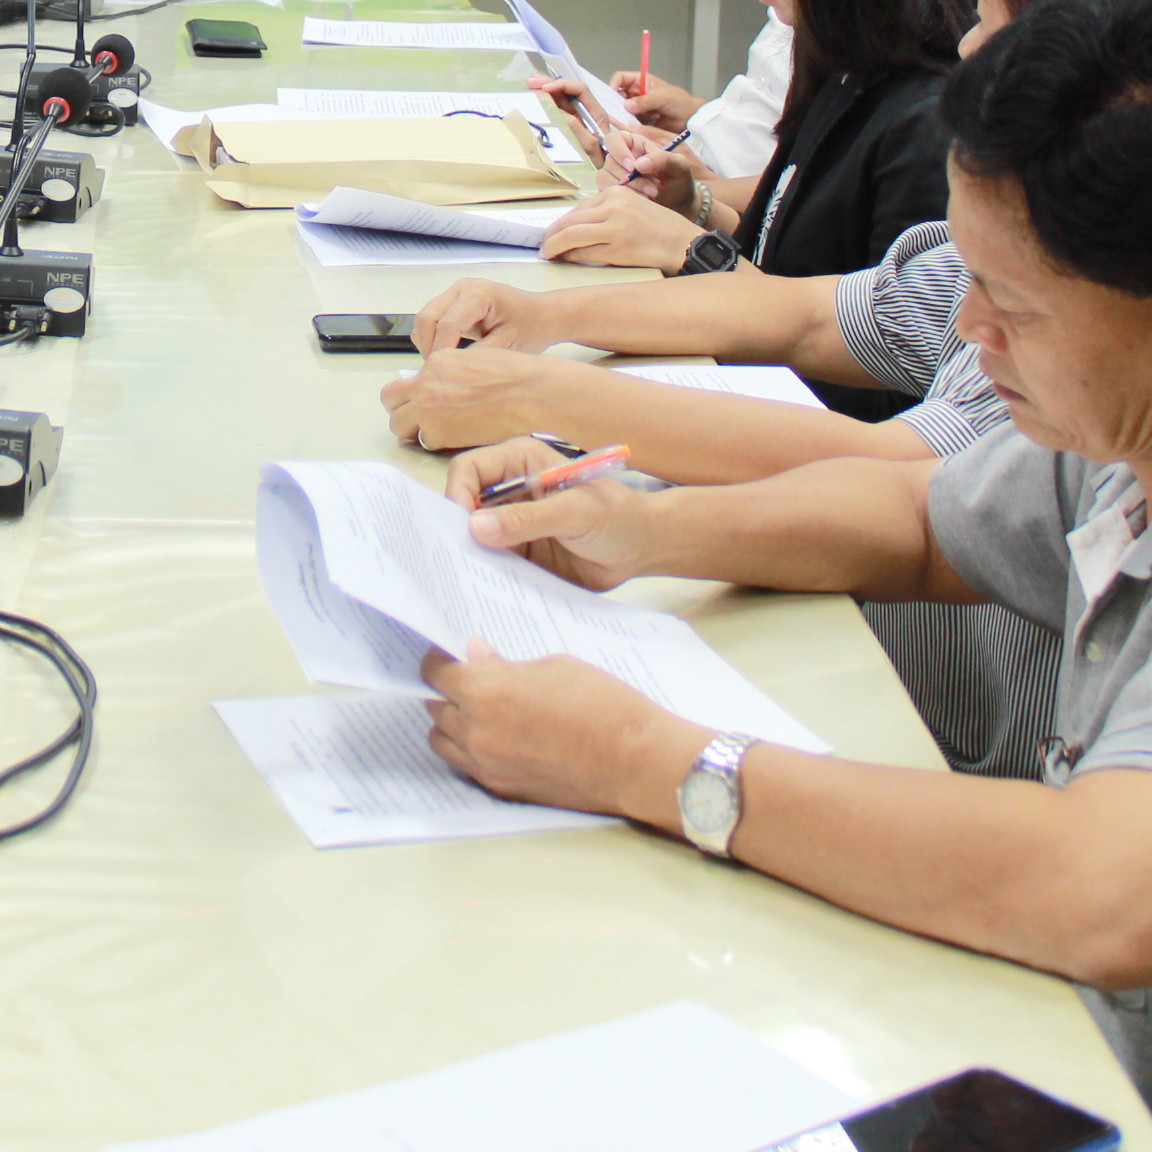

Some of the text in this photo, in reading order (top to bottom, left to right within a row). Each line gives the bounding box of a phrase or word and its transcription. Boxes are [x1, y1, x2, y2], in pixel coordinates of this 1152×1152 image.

[108, 77, 136, 86] NPE
[44, 166, 76, 177] NPE
[47, 272, 85, 285] NPE
